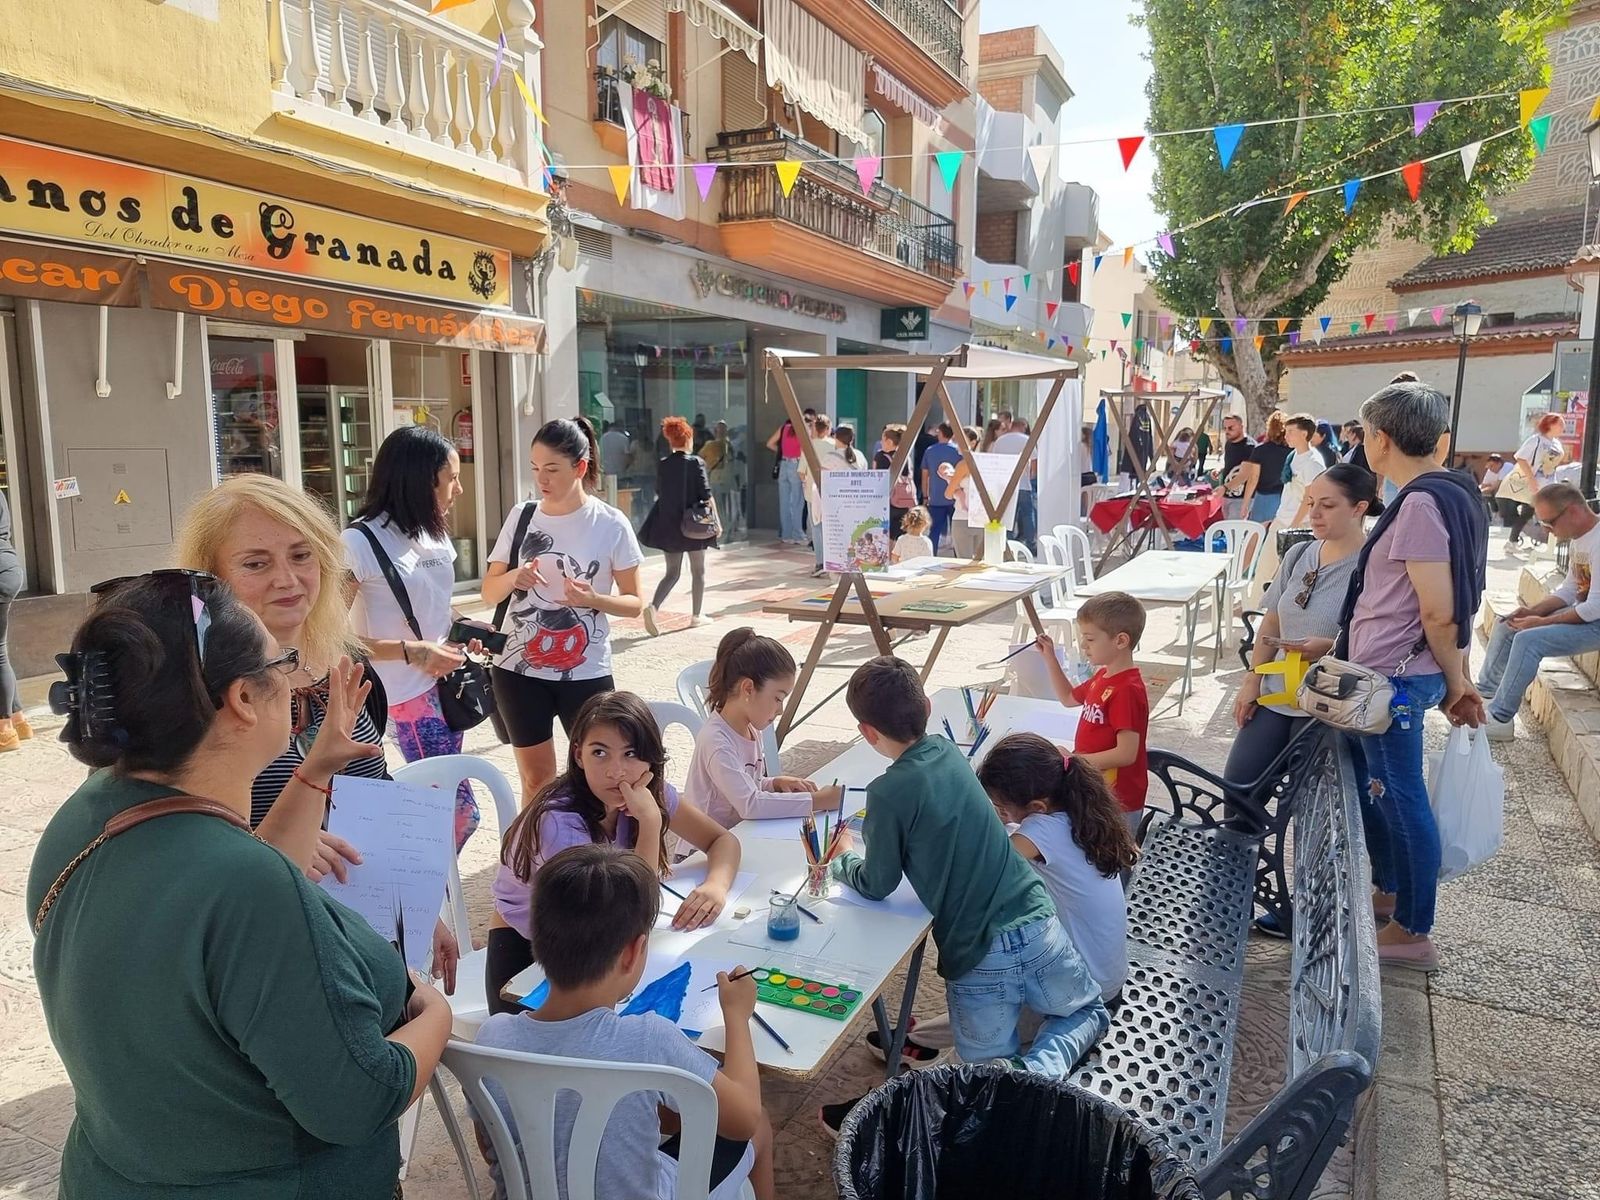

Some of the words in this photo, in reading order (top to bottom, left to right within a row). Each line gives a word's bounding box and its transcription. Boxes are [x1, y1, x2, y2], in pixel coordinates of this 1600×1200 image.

[83, 221, 116, 239] Del
[122, 228, 182, 249] Obrador
[171, 186, 234, 238] de
[259, 202, 456, 280] Granada
[0, 258, 121, 291] car
[169, 274, 329, 323] Diego
